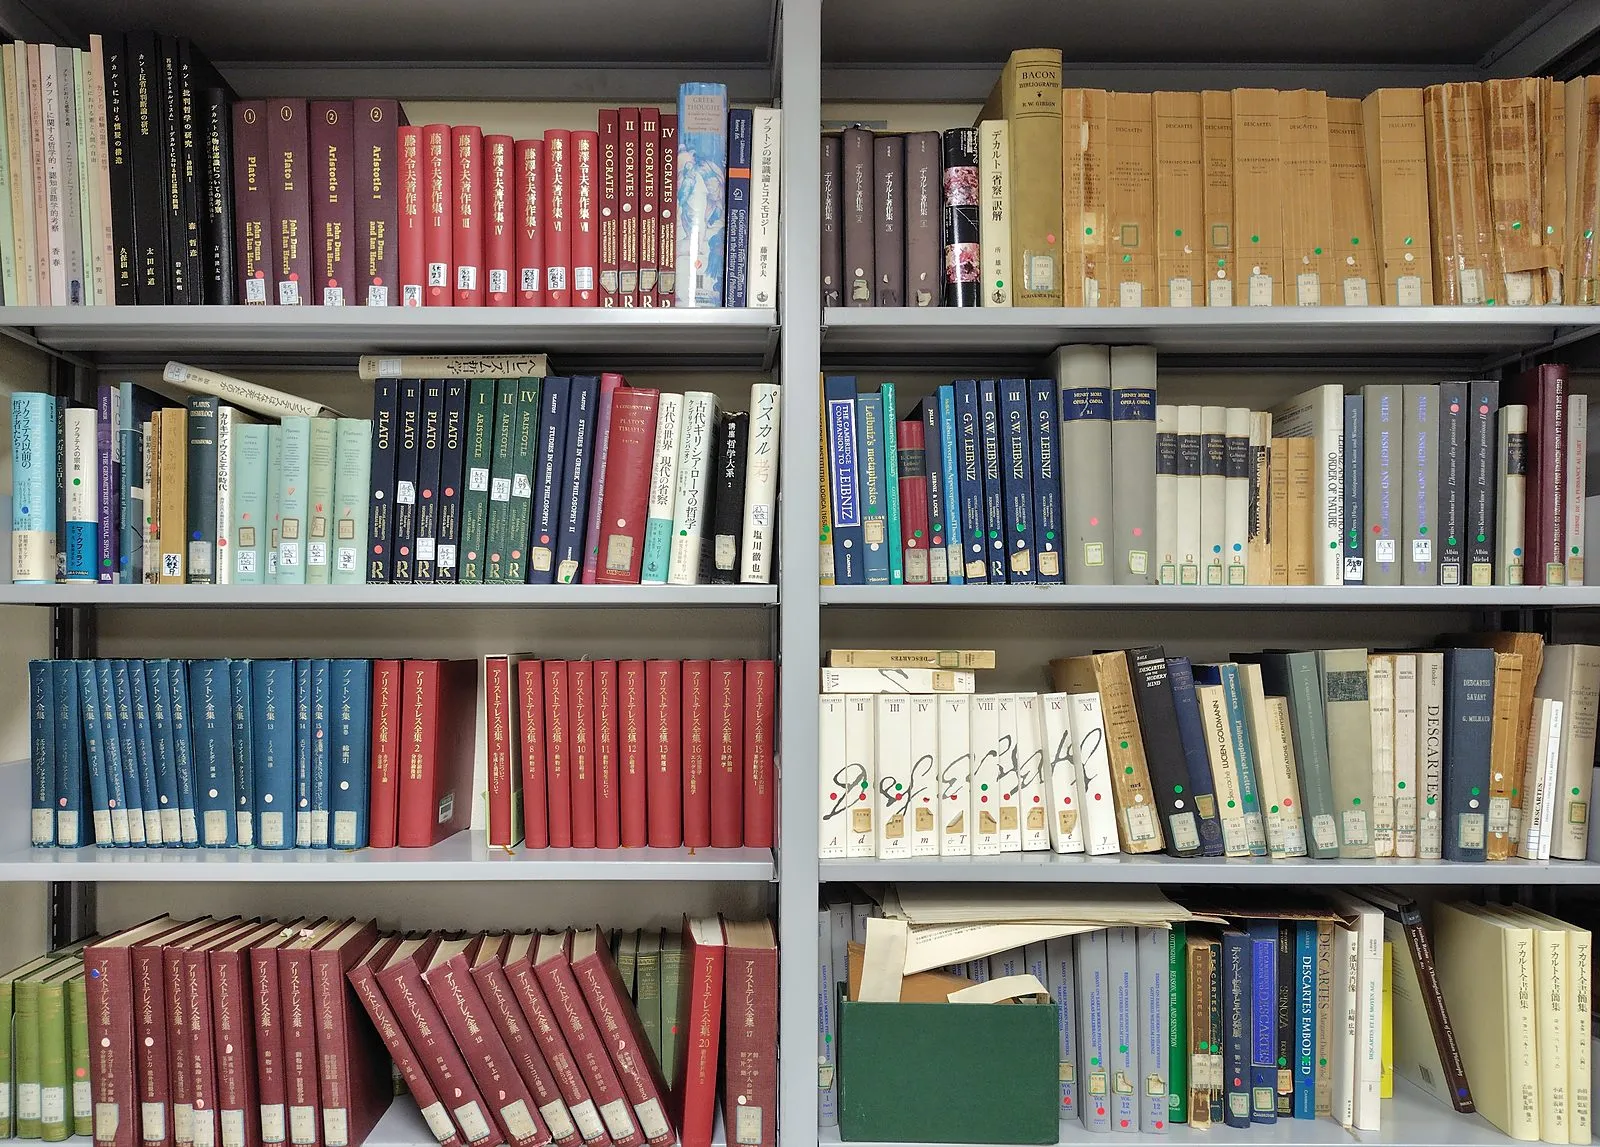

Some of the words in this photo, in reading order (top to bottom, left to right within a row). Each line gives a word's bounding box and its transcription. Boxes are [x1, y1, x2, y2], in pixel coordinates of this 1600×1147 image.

[248, 156, 256, 184] Plato
[284, 152, 293, 180] Plato
[285, 182, 293, 191] II
[329, 145, 338, 191] Aristotle
[373, 145, 381, 191] Aristotle
[605, 144, 613, 199] SOCRATES
[625, 142, 634, 197] SOCRATES
[645, 142, 654, 197] SOCRATES
[330, 194, 338, 203] II
[379, 411, 389, 449] PLATO
[404, 411, 415, 449] PLATO
[426, 411, 437, 449] PLATO
[447, 411, 458, 449] PLATO
[475, 412, 486, 458] ARISTOTLE
[500, 413, 510, 458] ARISTOTLE
[520, 411, 530, 456] ARISTOTLE
[576, 420, 585, 447] STUDIES
[835, 405, 843, 452] COMPANION
[843, 422, 851, 464] CAMBRIDGE
[865, 405, 875, 446] Leibniz's
[963, 413, 973, 437] G.W.
[1010, 411, 1020, 434] G.W.
[574, 458, 582, 480] GREEK
[838, 453, 844, 464] TO
[867, 448, 879, 504] metaphysics
[965, 439, 976, 480] LEIBNIZ
[1012, 437, 1023, 479] LEIBNIZ
[1328, 453, 1337, 478] ORDER
[569, 482, 580, 523] PHILOSOPHY
[839, 468, 853, 520] LEIBNIZ
[1328, 480, 1337, 490] OF
[103, 505, 109, 515] OF
[1328, 495, 1337, 528] NATURE
[380, 671, 389, 743] アリストテレス全集
[414, 671, 424, 743] アリストテレス全集
[493, 670, 503, 741] アリストテレス全集
[525, 671, 536, 744] アリストテレス全集
[551, 671, 562, 744] アリストテレス全集
[576, 671, 586, 744] アリストテレス全集
[601, 671, 610, 744] アリストテレス全集
[628, 671, 636, 743] アリストテレス全集
[659, 671, 668, 744] アリストテレス全集
[692, 671, 701, 743] アリストテレス全集
[722, 671, 732, 744] アリストテレス全集
[890, 704, 900, 712] III
[918, 704, 928, 712] IV
[978, 703, 993, 711] VIII
[1212, 700, 1227, 743] GOLDMANN
[415, 744, 420, 752] 2
[1220, 745, 1229, 769] LUCIEN
[1427, 705, 1439, 800] DESCARTES
[100, 960, 111, 1025] アリストテレス全集
[141, 959, 153, 1025] アリストテレス全集
[745, 961, 754, 1027] アリストテレス全集
[1302, 956, 1312, 1014] DESCARTES
[1318, 933, 1331, 1009] DESCARTES
[258, 961, 272, 1028] アリストテレス全集
[290, 961, 302, 1028] アリストテレス全集
[395, 975, 432, 1038] アリストテレス全集
[445, 972, 481, 1035] アリストテレス全集
[518, 971, 552, 1035] アリストテレス全集
[549, 969, 583, 1033] アリストテレス全集
[700, 957, 714, 1037] アリストテレス全集
[1279, 986, 1289, 1029] SPINOZA
[699, 1039, 710, 1048] 20
[1301, 1017, 1311, 1075] EMBODED
